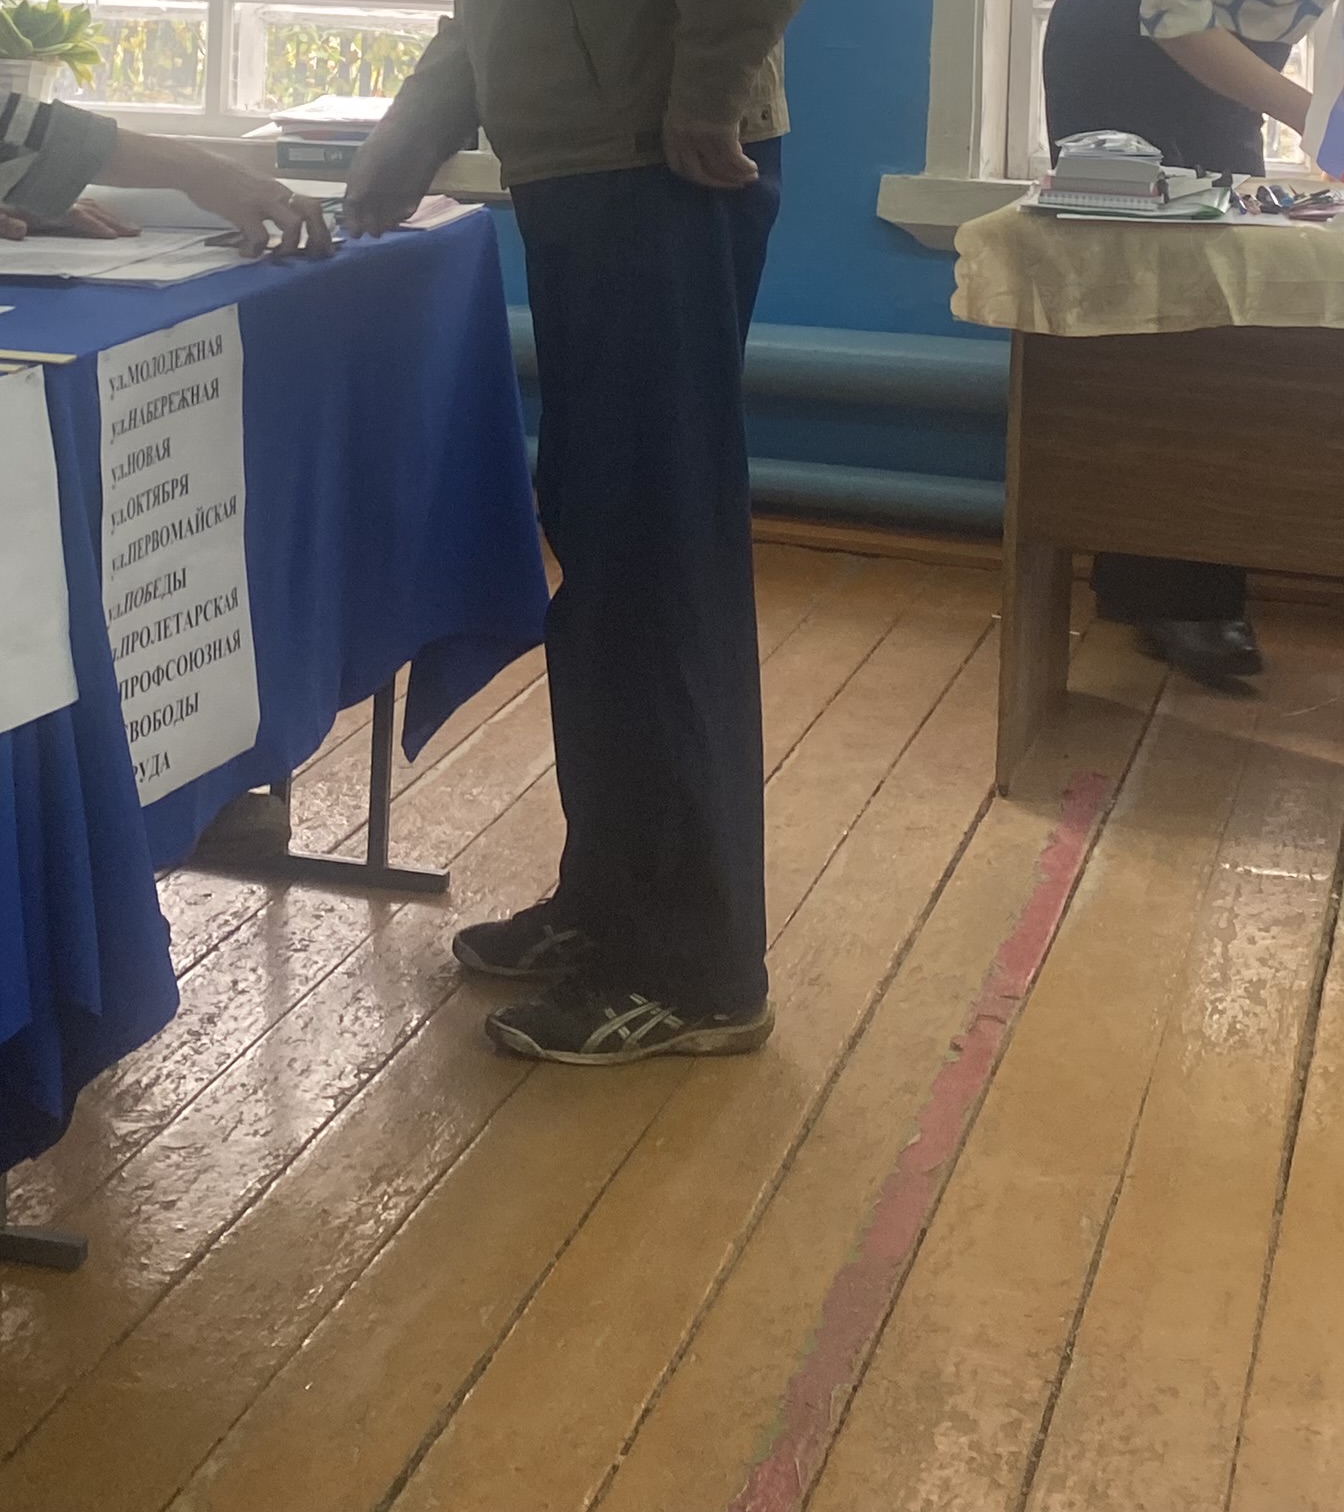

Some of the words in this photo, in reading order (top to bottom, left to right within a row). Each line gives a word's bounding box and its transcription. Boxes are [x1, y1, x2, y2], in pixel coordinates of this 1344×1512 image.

[109, 334, 223, 401] ул.МОЛОДЕЖНАЯ
[110, 377, 219, 445] ул.НАБЕРЕЖНАЯ
[111, 437, 171, 490] ул.НОВАЯ
[111, 473, 189, 536] ул.ОКТЯБРЯ
[111, 494, 237, 581] ул.ПЕРВОМАЙСКАЯ
[106, 567, 187, 629] ул.ПОБЕДЫ
[125, 691, 199, 743] ВОБОДЫ
